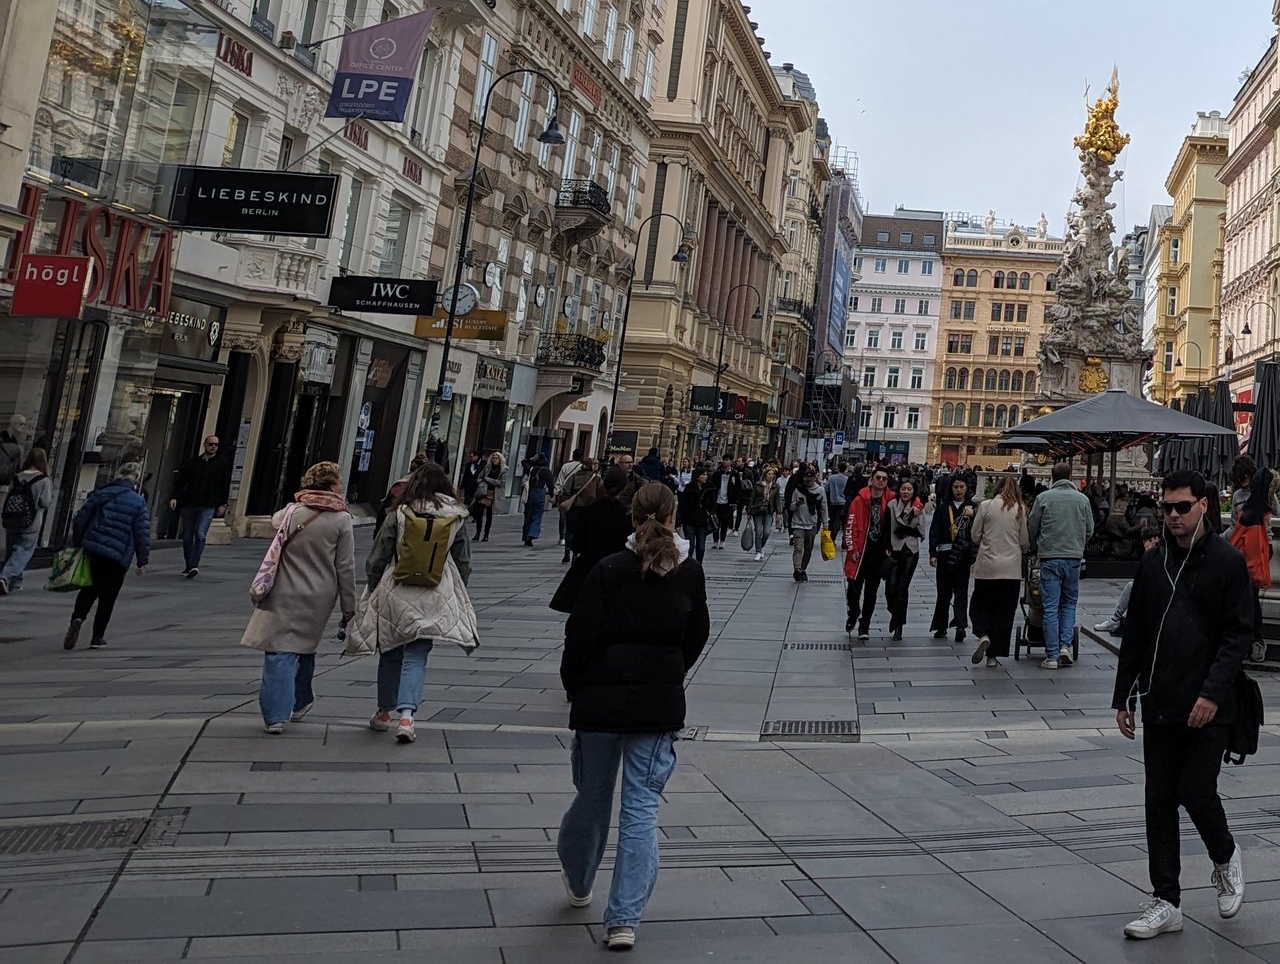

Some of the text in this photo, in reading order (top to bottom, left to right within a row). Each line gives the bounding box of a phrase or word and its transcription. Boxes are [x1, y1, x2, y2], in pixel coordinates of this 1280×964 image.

[216, 33, 254, 78] LISKA
[350, 61, 403, 72] OFFICE CENTER
[341, 78, 399, 101] LPE
[198, 187, 327, 205] LIEBESKIND
[241, 208, 279, 216] BERLIN
[371, 282, 410, 299] IWC
[355, 299, 420, 309] SCHAFFHAUSEN
[166, 310, 206, 330] IEBESKIND
[486, 364, 508, 382] KNIZE
